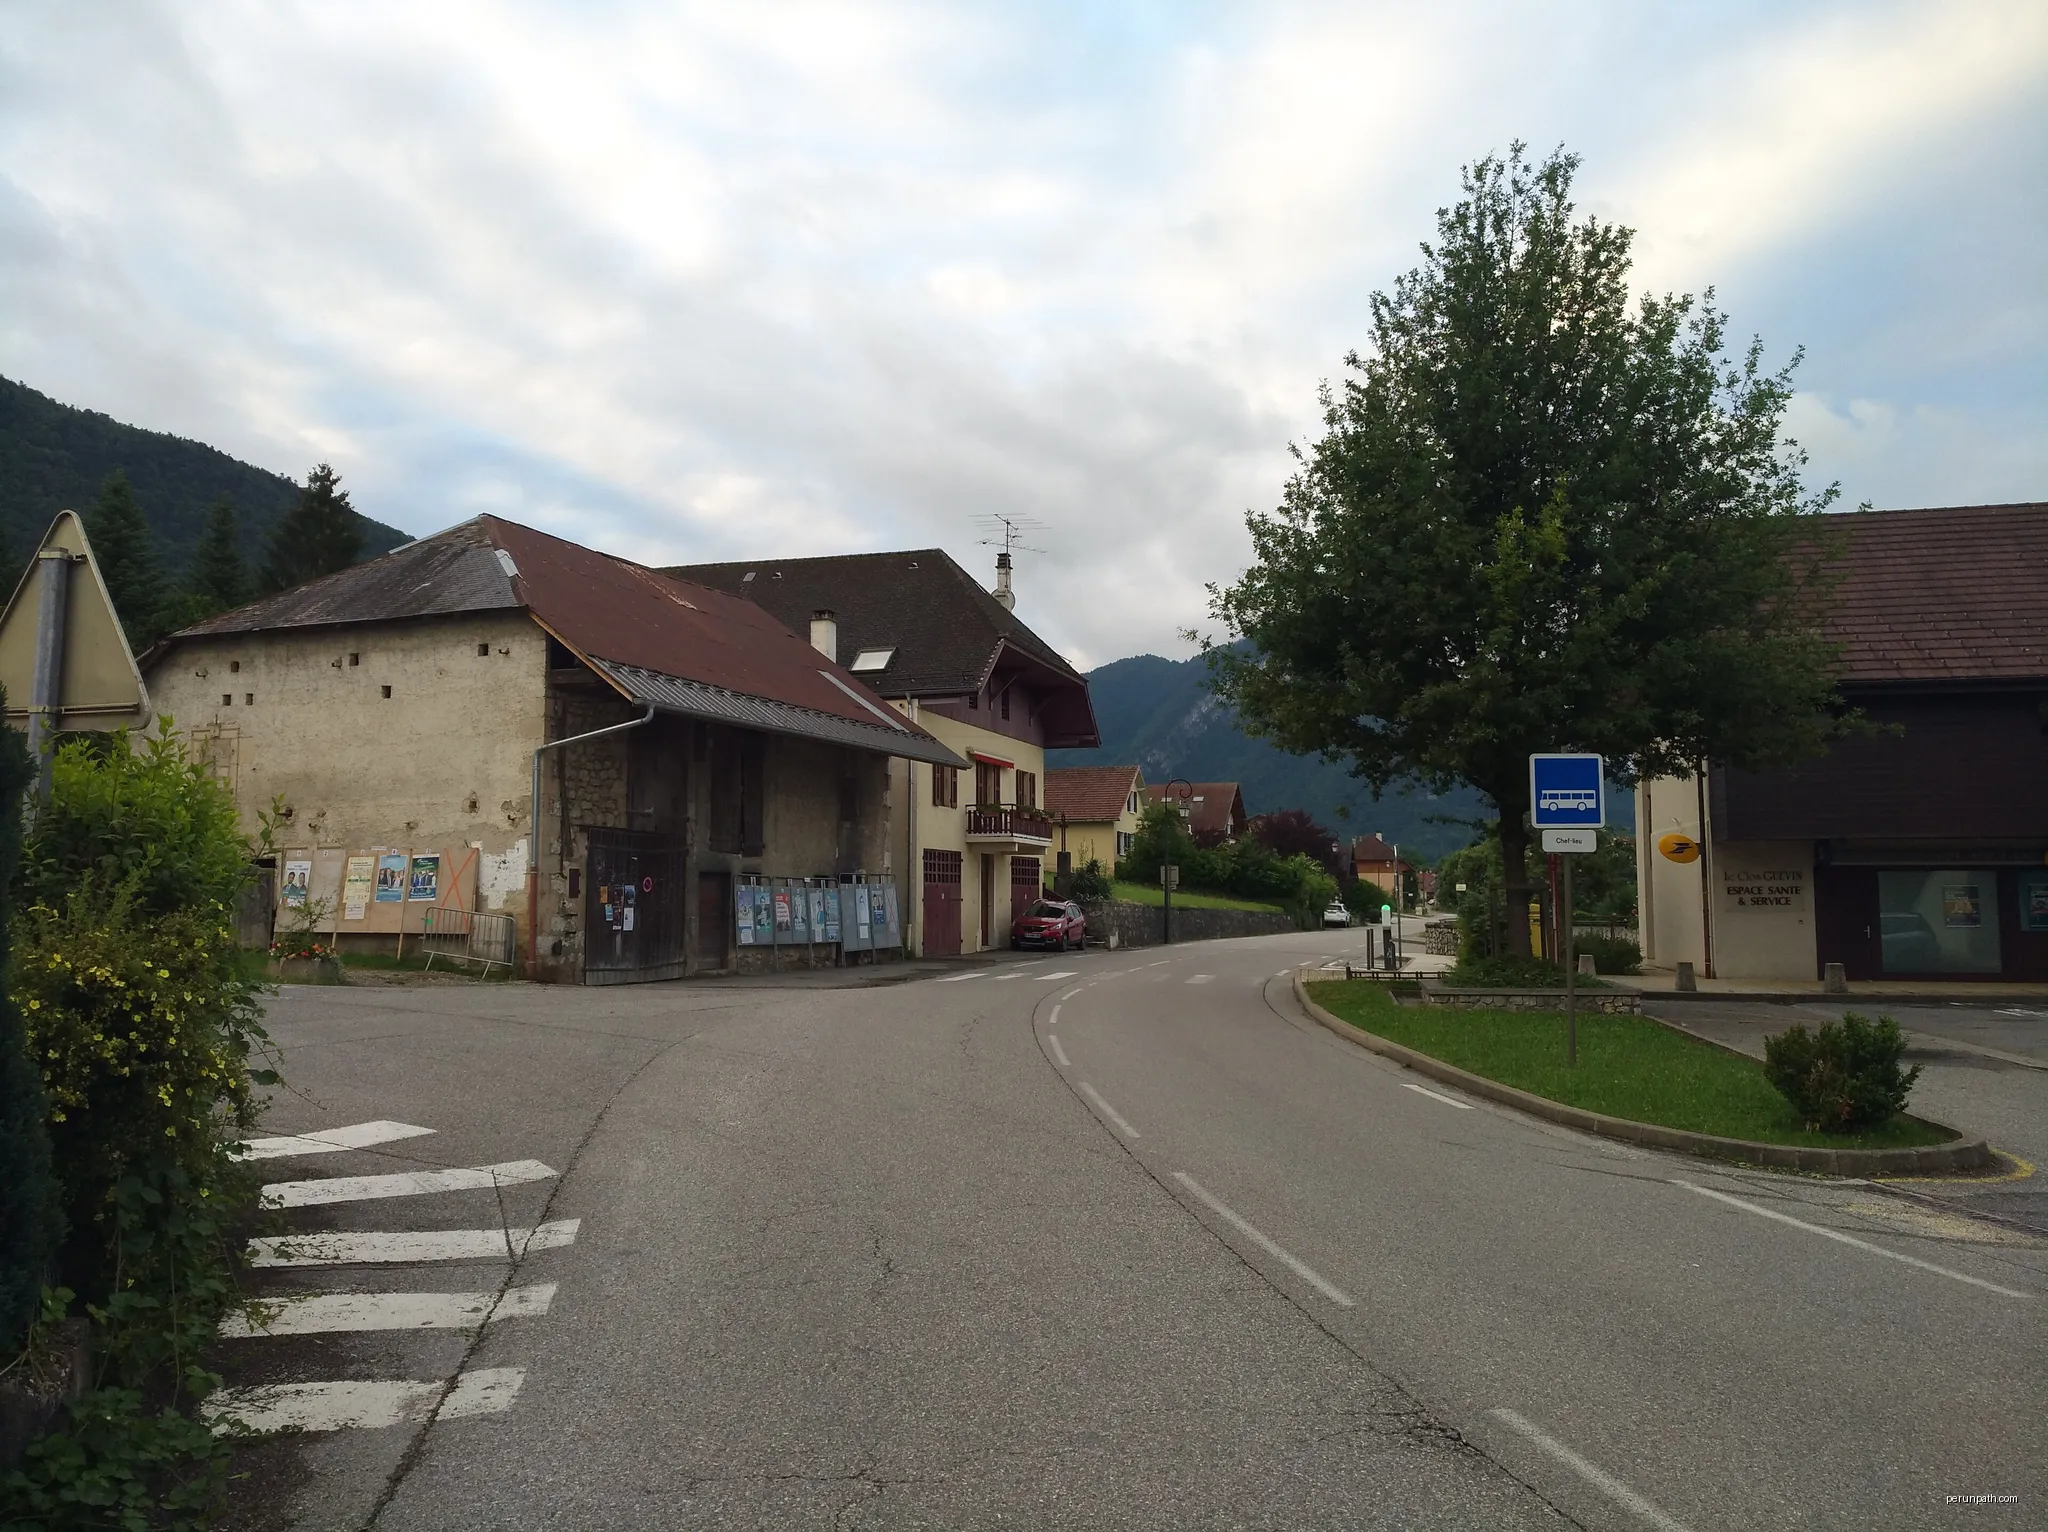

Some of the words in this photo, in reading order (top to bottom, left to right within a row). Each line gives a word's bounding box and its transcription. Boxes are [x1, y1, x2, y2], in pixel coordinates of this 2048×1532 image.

[1727, 886, 1763, 895] ESPACE
[1737, 896, 1746, 906] &
[1750, 896, 1792, 906] SERVICE
